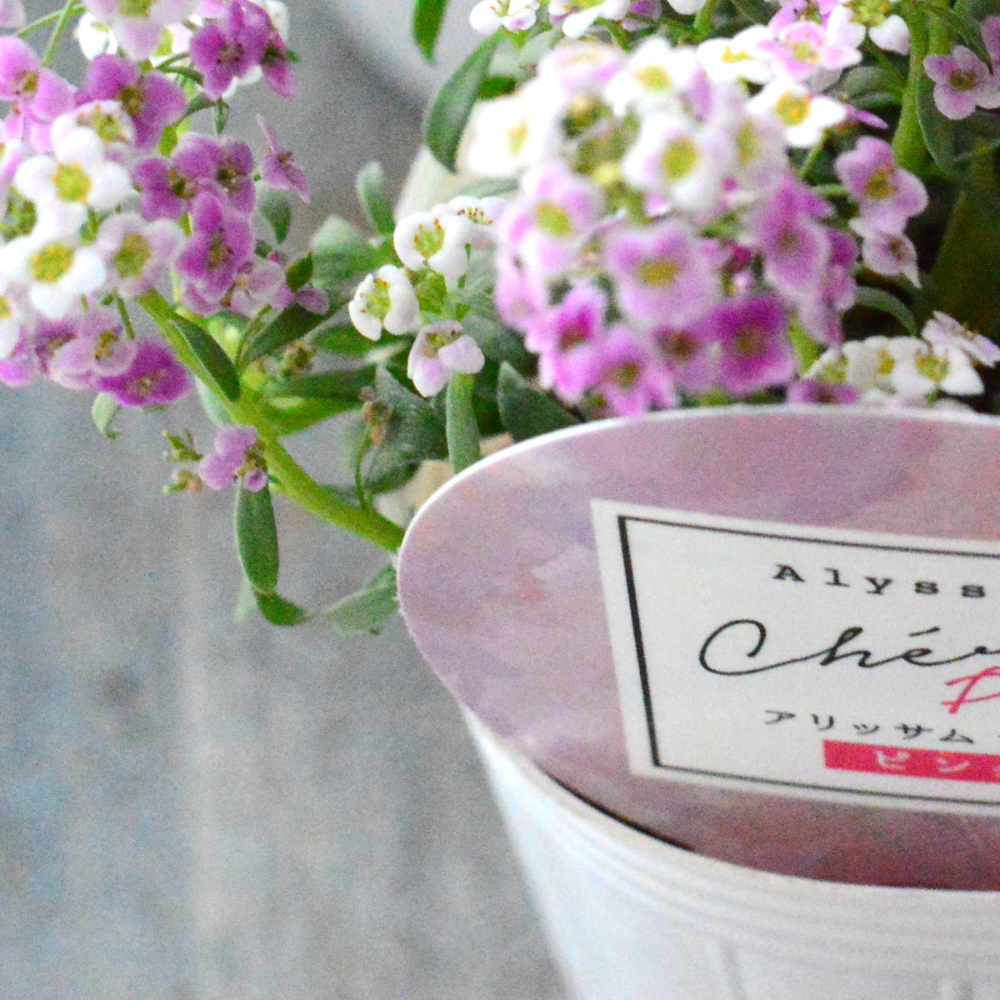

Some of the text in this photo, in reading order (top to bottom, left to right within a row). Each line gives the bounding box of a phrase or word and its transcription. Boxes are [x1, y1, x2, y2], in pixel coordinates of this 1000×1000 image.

[763, 710, 976, 746] アリッサム
